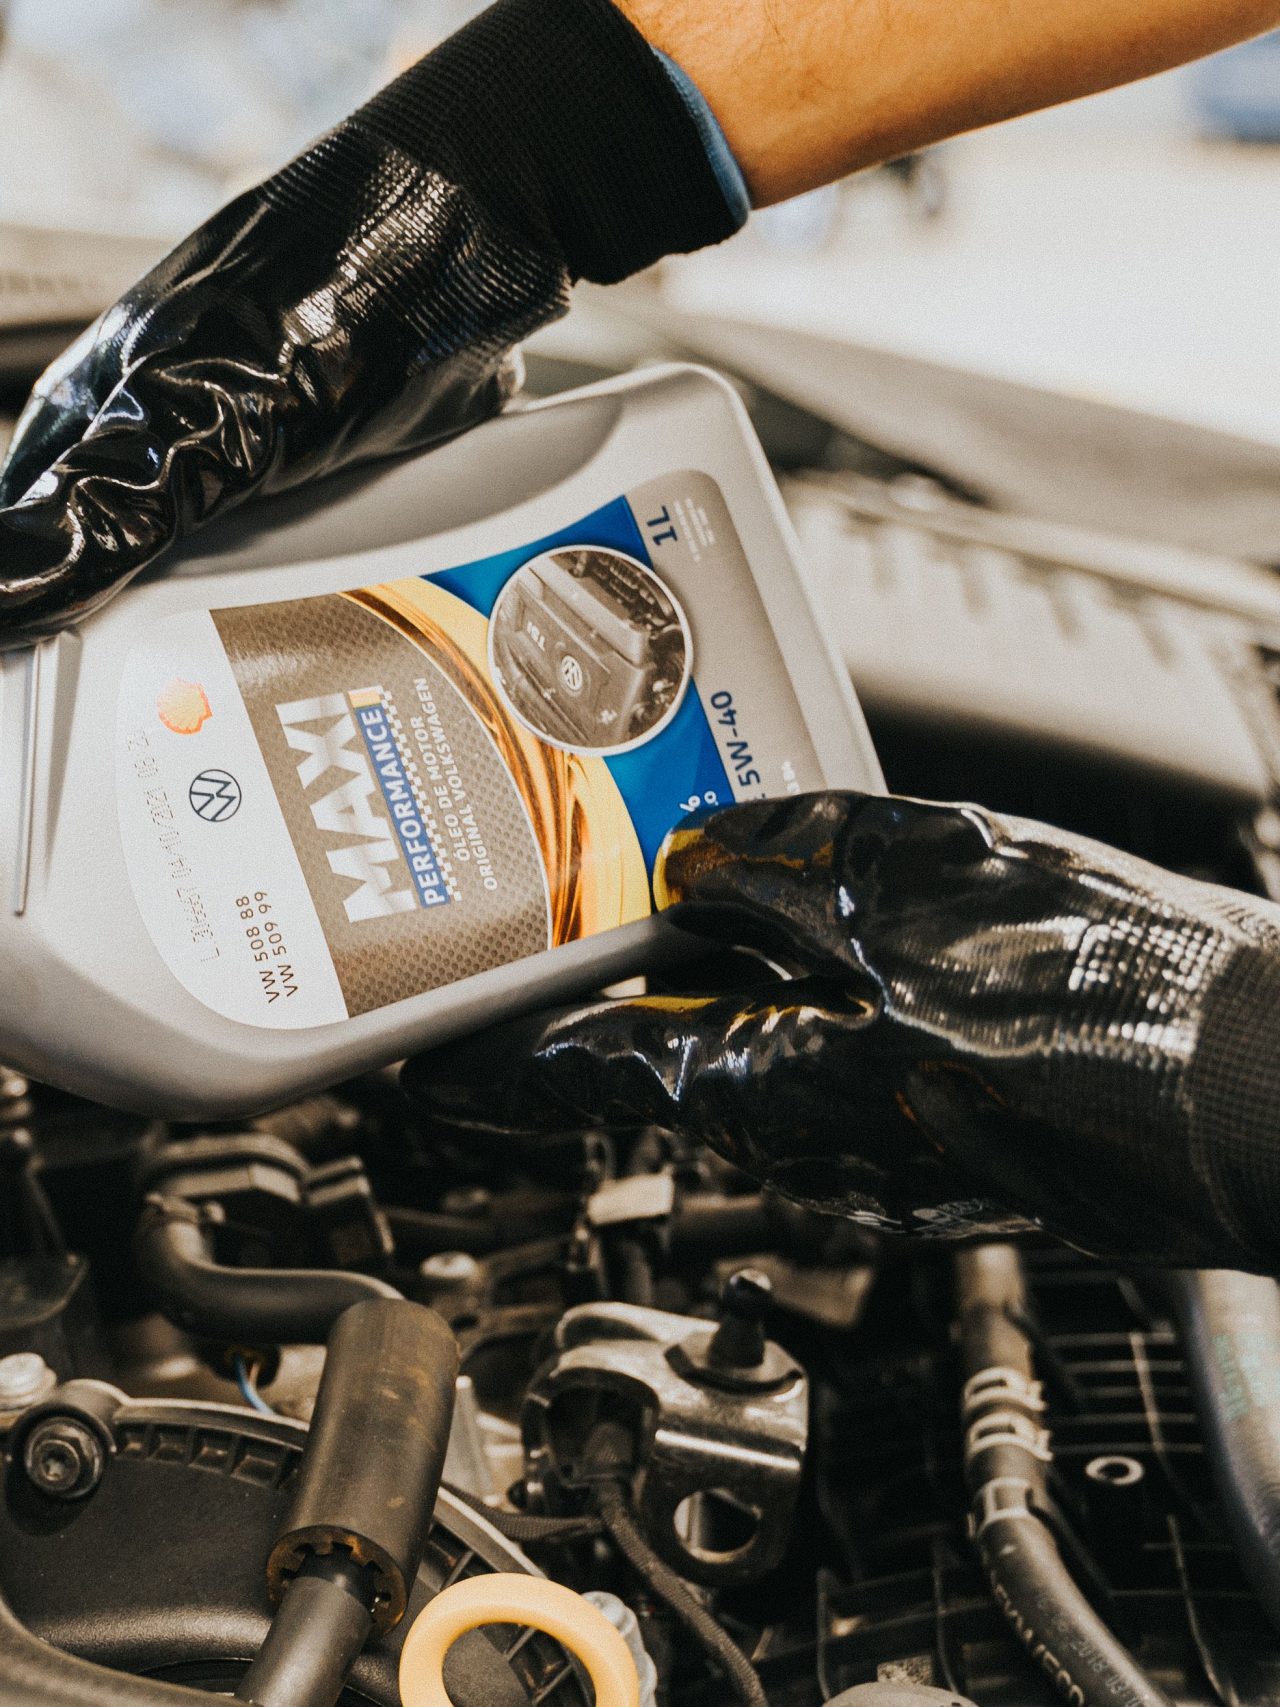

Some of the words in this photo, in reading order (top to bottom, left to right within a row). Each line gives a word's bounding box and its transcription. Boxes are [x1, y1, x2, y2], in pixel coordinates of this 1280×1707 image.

[646, 505, 678, 546] 1L
[410, 715, 443, 781] MOTOR
[413, 677, 467, 801] VOLKSWAGEN
[710, 690, 761, 787] 5W-40
[274, 692, 417, 924] MAXI
[360, 707, 446, 905] PERFORMANCE
[433, 784, 453, 810] DE
[445, 814, 470, 862] ÓLEO
[462, 804, 498, 891] ORIGINAL
[235, 895, 255, 920] 88
[253, 890, 273, 914] 99
[245, 925, 269, 962] 508
[263, 921, 288, 956] 509
[259, 970, 280, 1003] VW
[277, 964, 299, 997] VW
